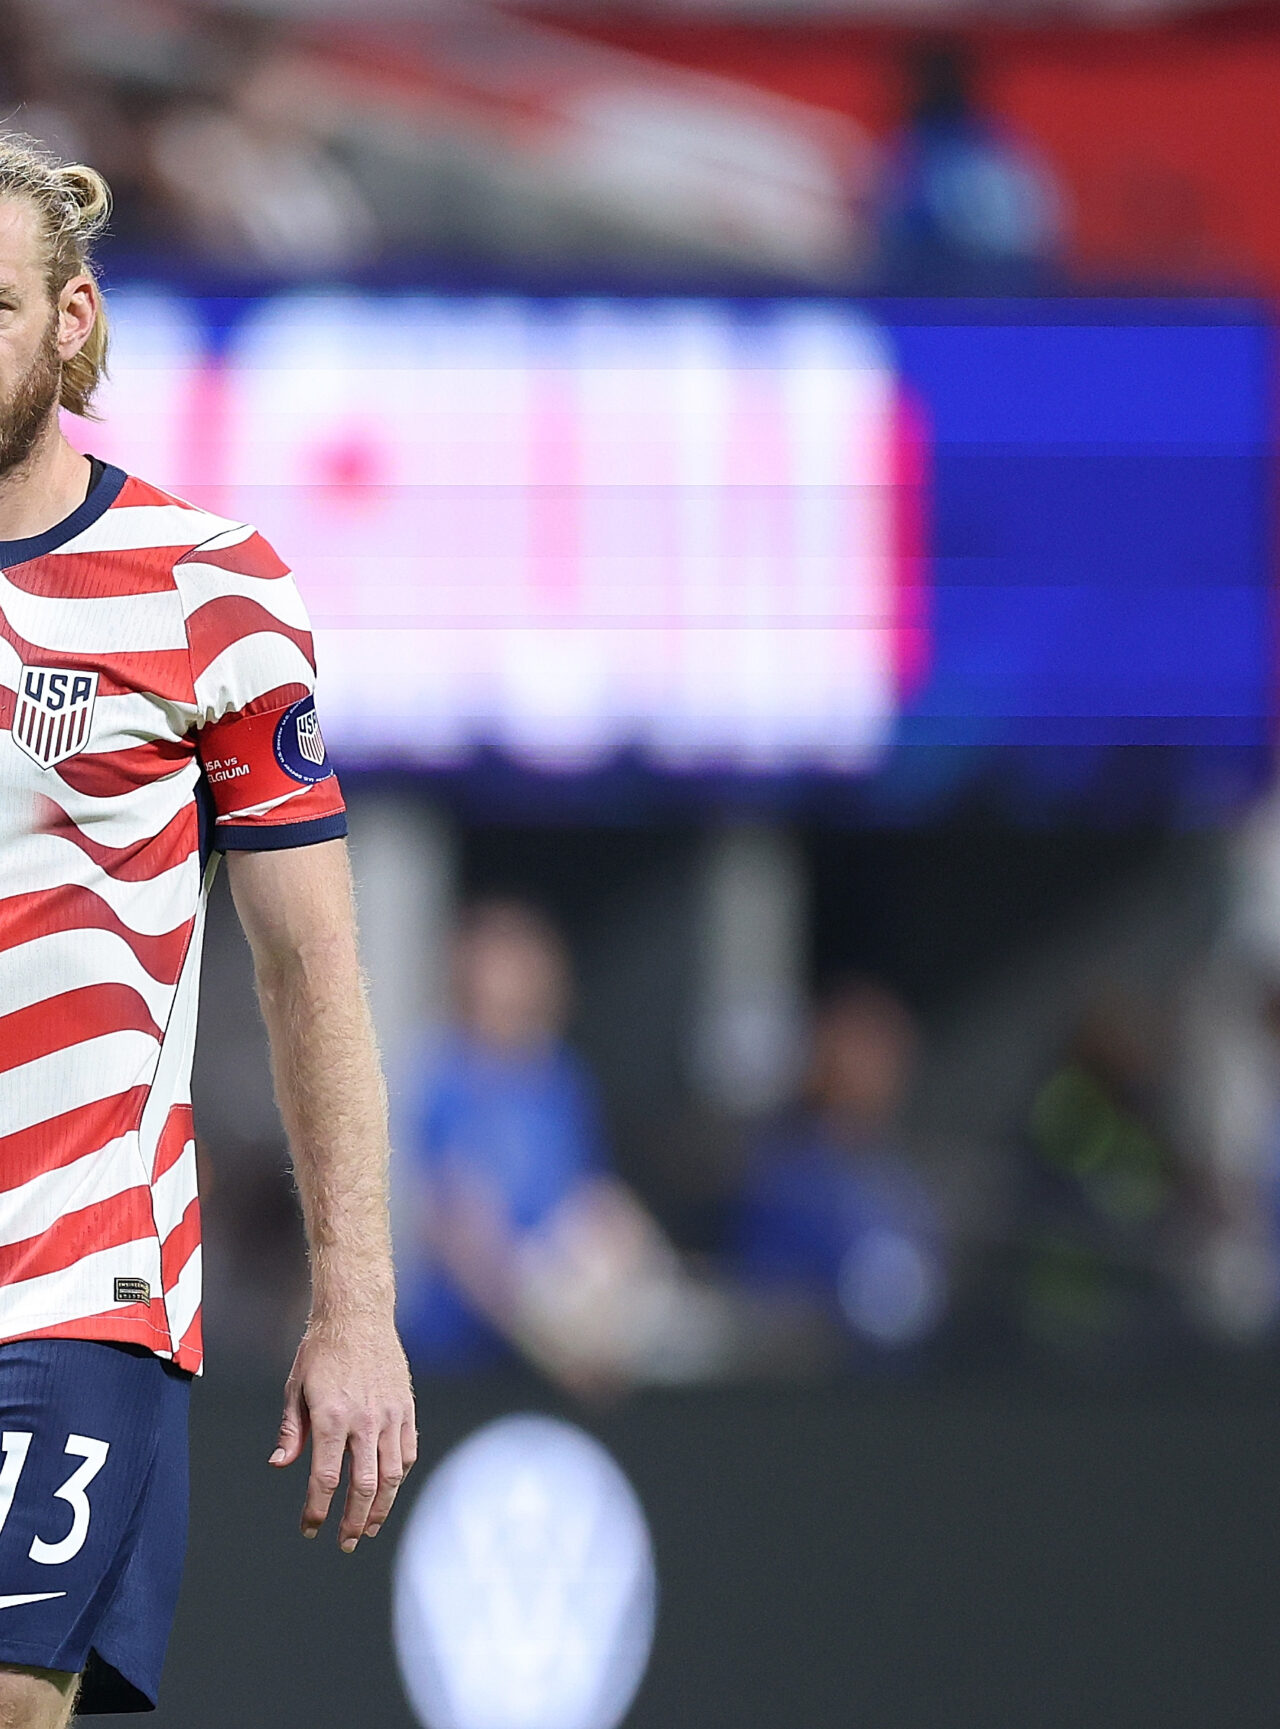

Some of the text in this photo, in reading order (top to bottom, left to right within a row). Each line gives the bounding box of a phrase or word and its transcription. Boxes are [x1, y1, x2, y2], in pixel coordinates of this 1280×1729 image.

[24, 671, 92, 711] USA
[223, 756, 238, 767] vs
[207, 764, 250, 783] ELGIUM
